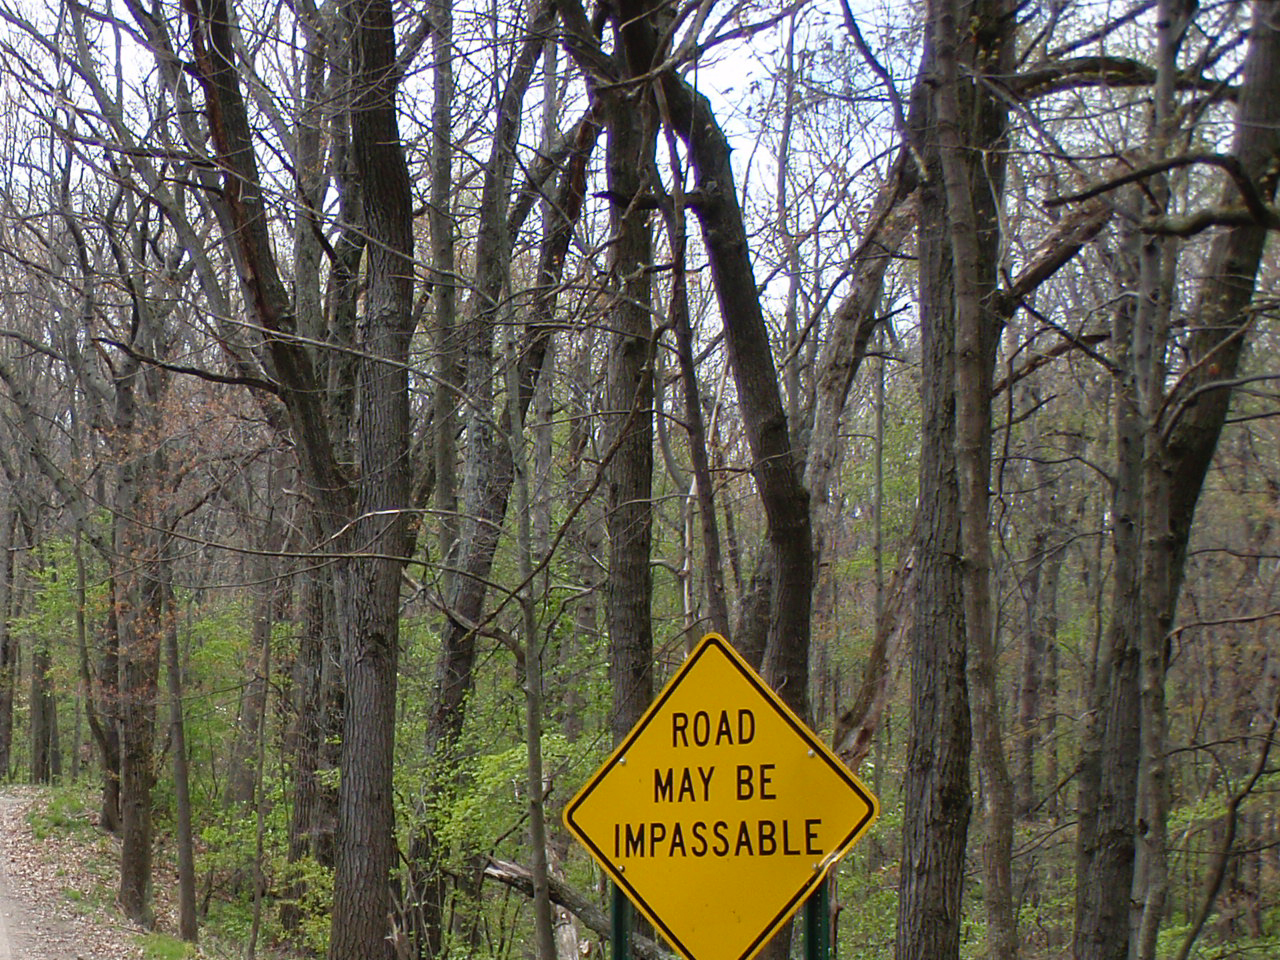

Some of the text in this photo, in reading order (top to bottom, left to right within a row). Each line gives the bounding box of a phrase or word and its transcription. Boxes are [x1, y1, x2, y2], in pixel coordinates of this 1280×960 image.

[672, 708, 756, 748] ROAD
[653, 763, 777, 804] MAY BE
[614, 818, 824, 859] IMPASSABLE
